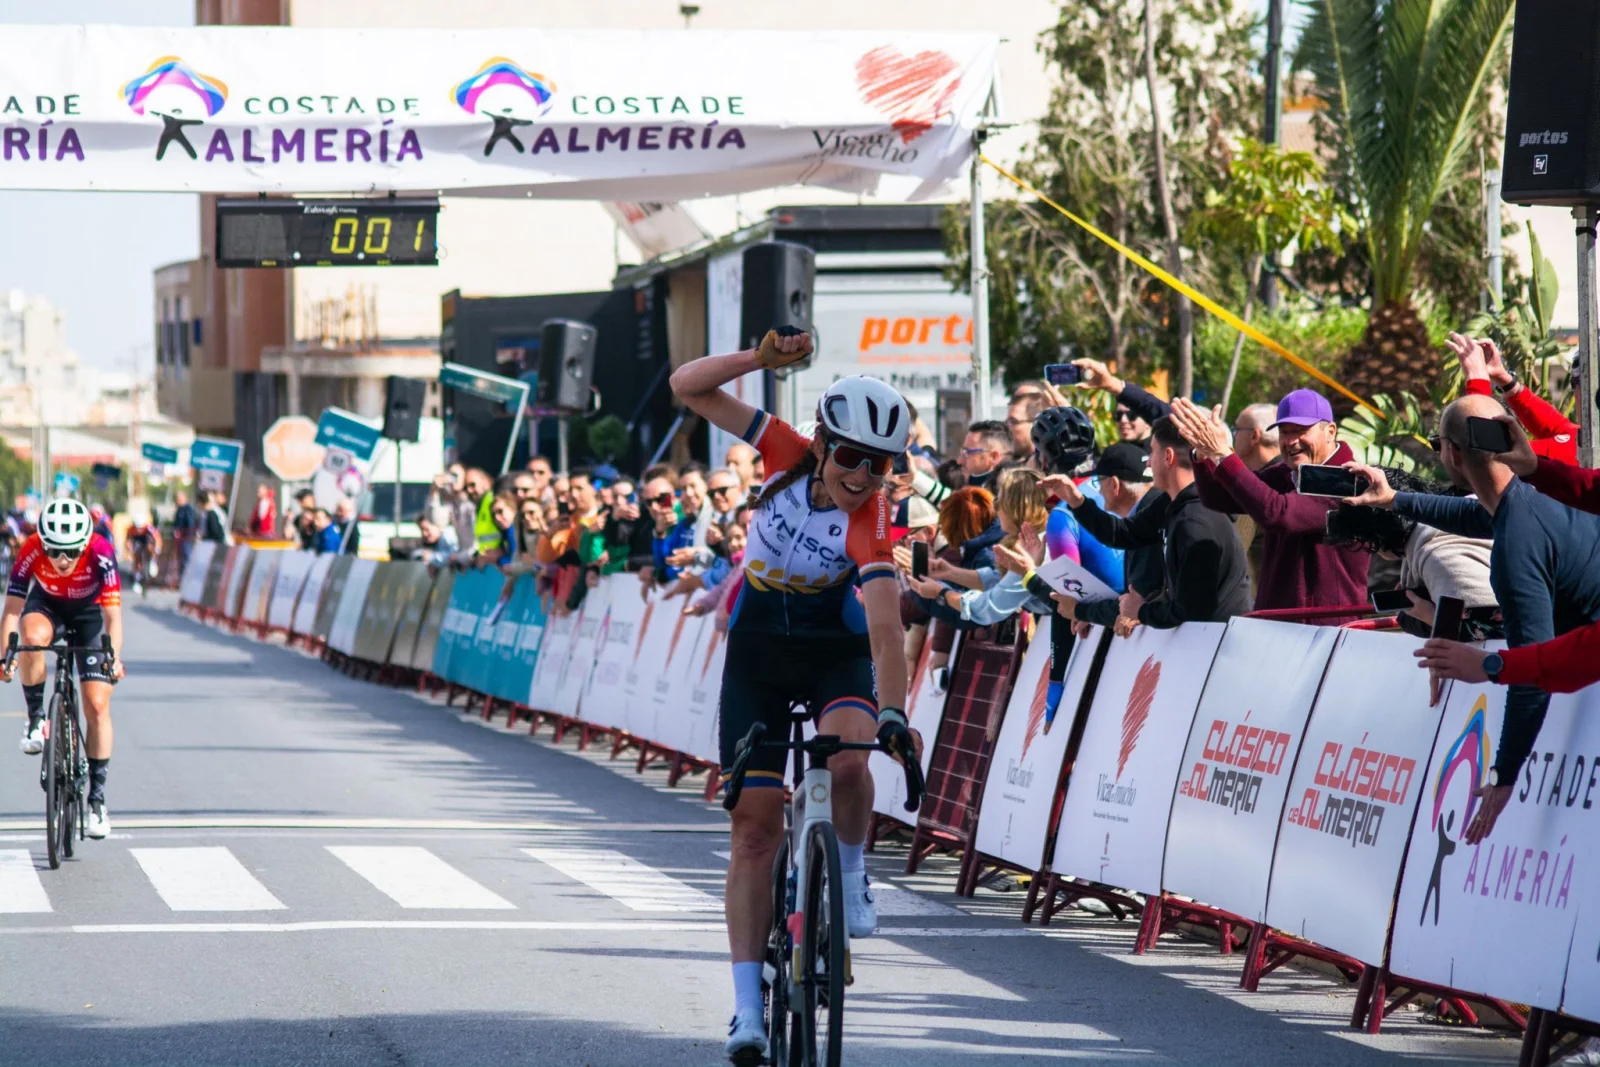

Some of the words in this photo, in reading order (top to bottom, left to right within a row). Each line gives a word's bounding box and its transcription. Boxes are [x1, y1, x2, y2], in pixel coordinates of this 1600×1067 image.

[36, 94, 81, 116] DE
[244, 96, 361, 115] COSTA
[377, 97, 420, 117] DE
[571, 95, 692, 116] COSTA
[701, 96, 745, 115] DE
[3, 118, 85, 162] RÍA
[205, 118, 424, 163] ALMERÍA
[531, 119, 746, 156] ALMERÍA
[1463, 834, 1575, 910] ALMERÍA
